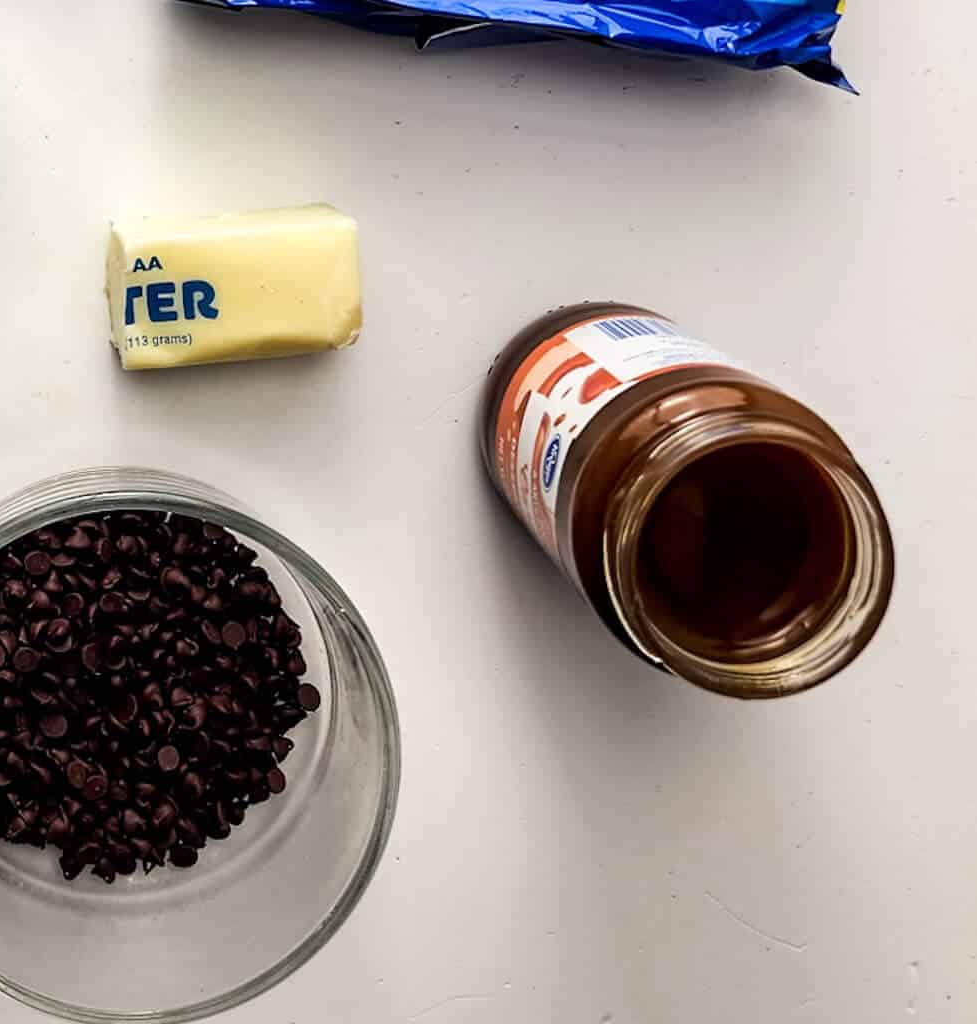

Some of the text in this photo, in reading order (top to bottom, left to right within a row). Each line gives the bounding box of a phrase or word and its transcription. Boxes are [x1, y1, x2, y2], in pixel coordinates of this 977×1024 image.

[133, 256, 163, 273] AA
[124, 279, 219, 326] TER
[152, 333, 193, 347] grams)
